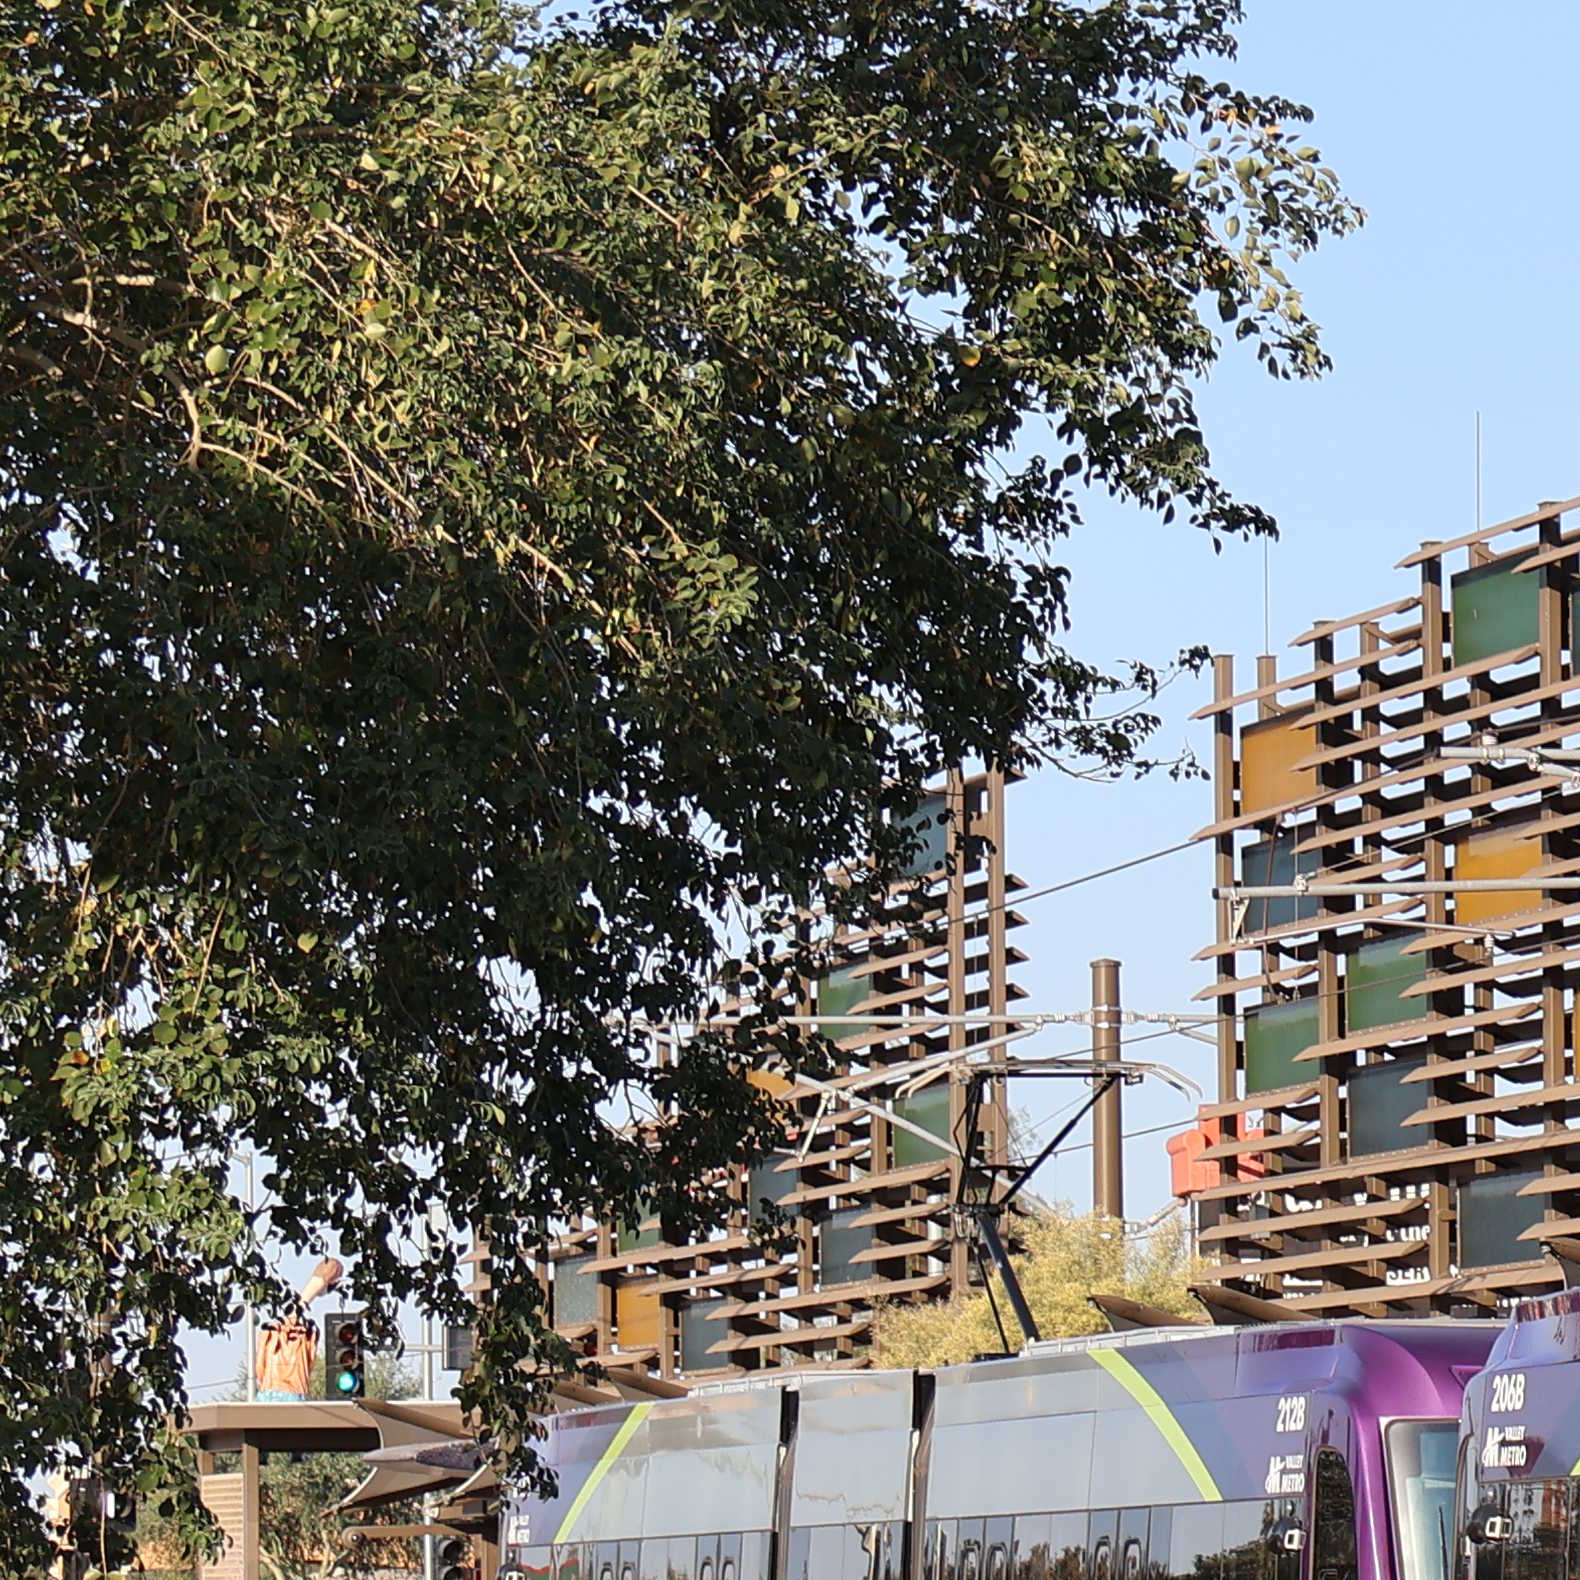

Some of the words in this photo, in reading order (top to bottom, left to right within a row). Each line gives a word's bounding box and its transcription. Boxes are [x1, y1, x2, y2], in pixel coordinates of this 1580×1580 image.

[1490, 1373, 1526, 1413] 206B
[1276, 1396, 1306, 1432] 212B
[1504, 1426, 1526, 1441] VALLEY
[1500, 1445, 1527, 1467] METRO
[1281, 1473, 1306, 1493] METRO
